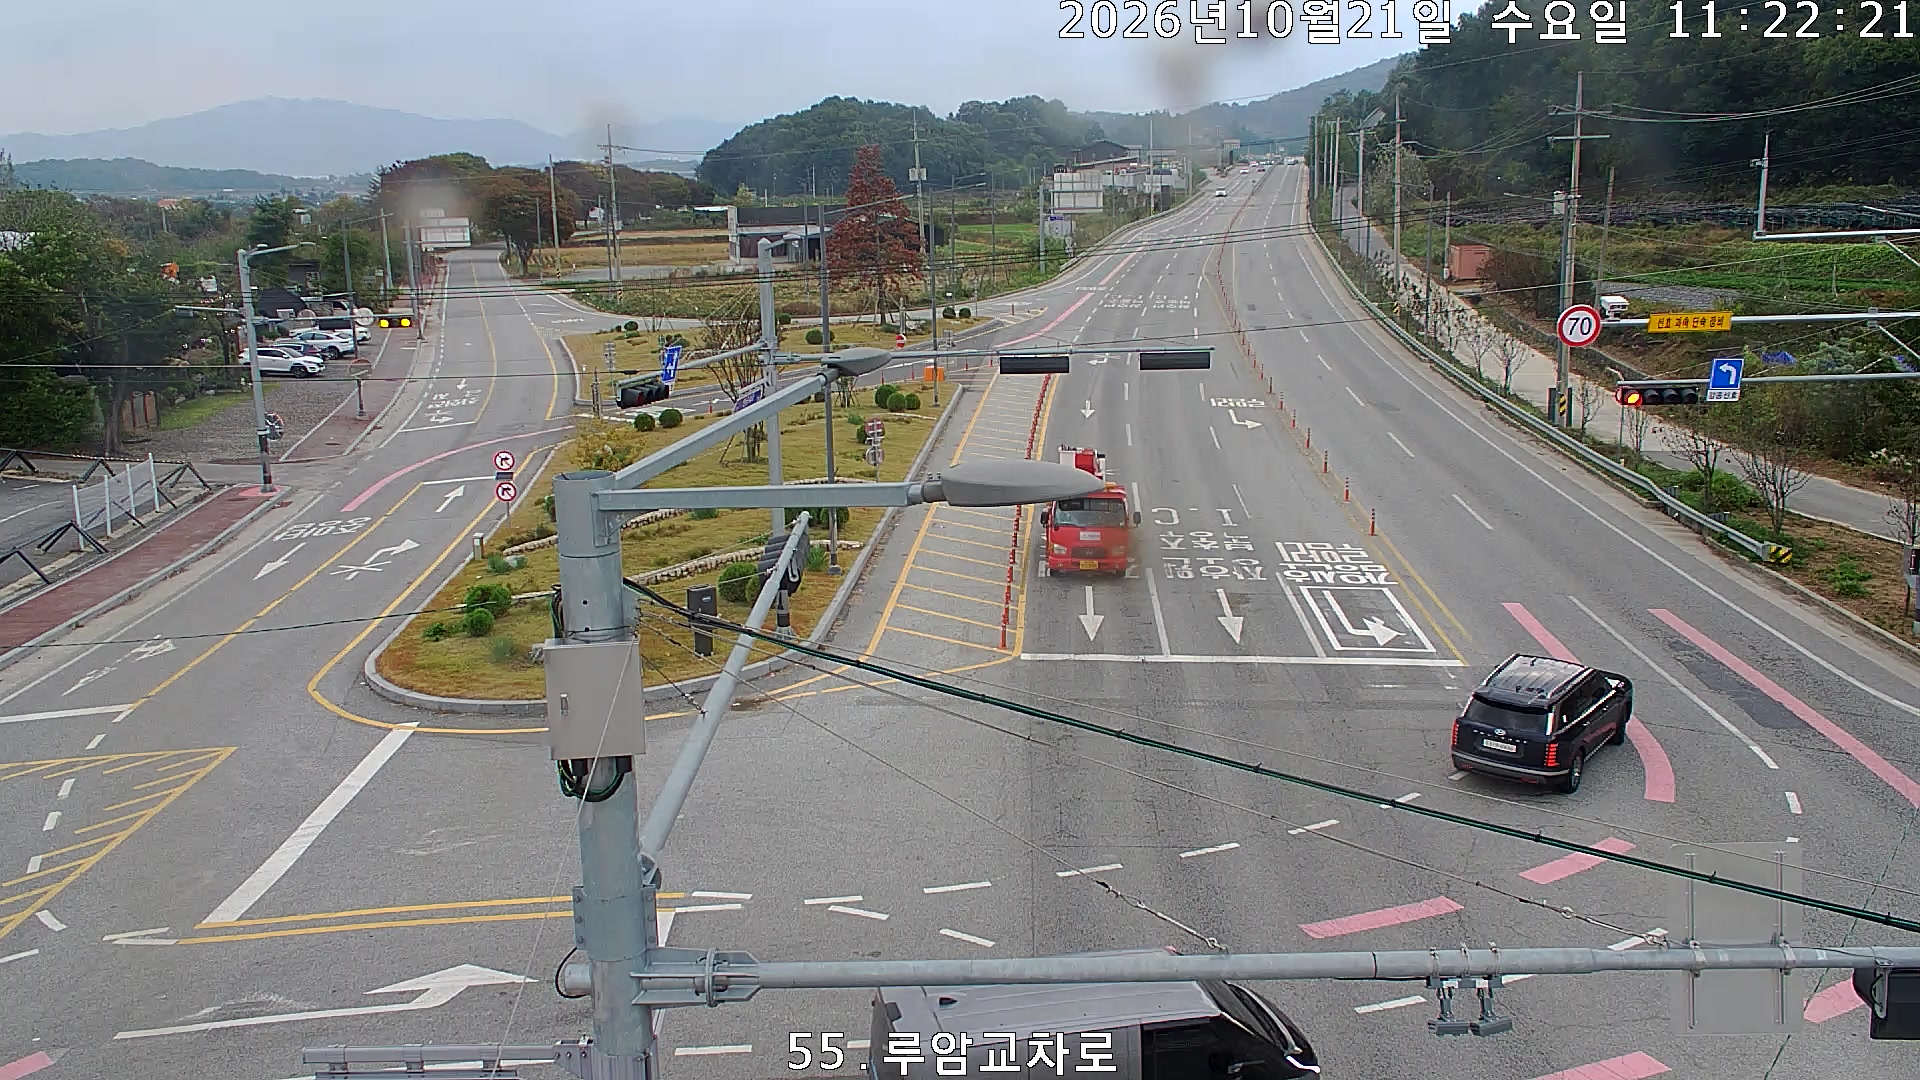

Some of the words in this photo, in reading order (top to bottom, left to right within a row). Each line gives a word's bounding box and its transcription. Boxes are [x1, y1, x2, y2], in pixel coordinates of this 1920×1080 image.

[1568, 316, 1592, 336] 70
[1160, 531, 1255, 551] 북충주
[1275, 541, 1373, 563] 루암리
[1162, 556, 1267, 581] 장호원
[1279, 562, 1399, 585] 감응신호
